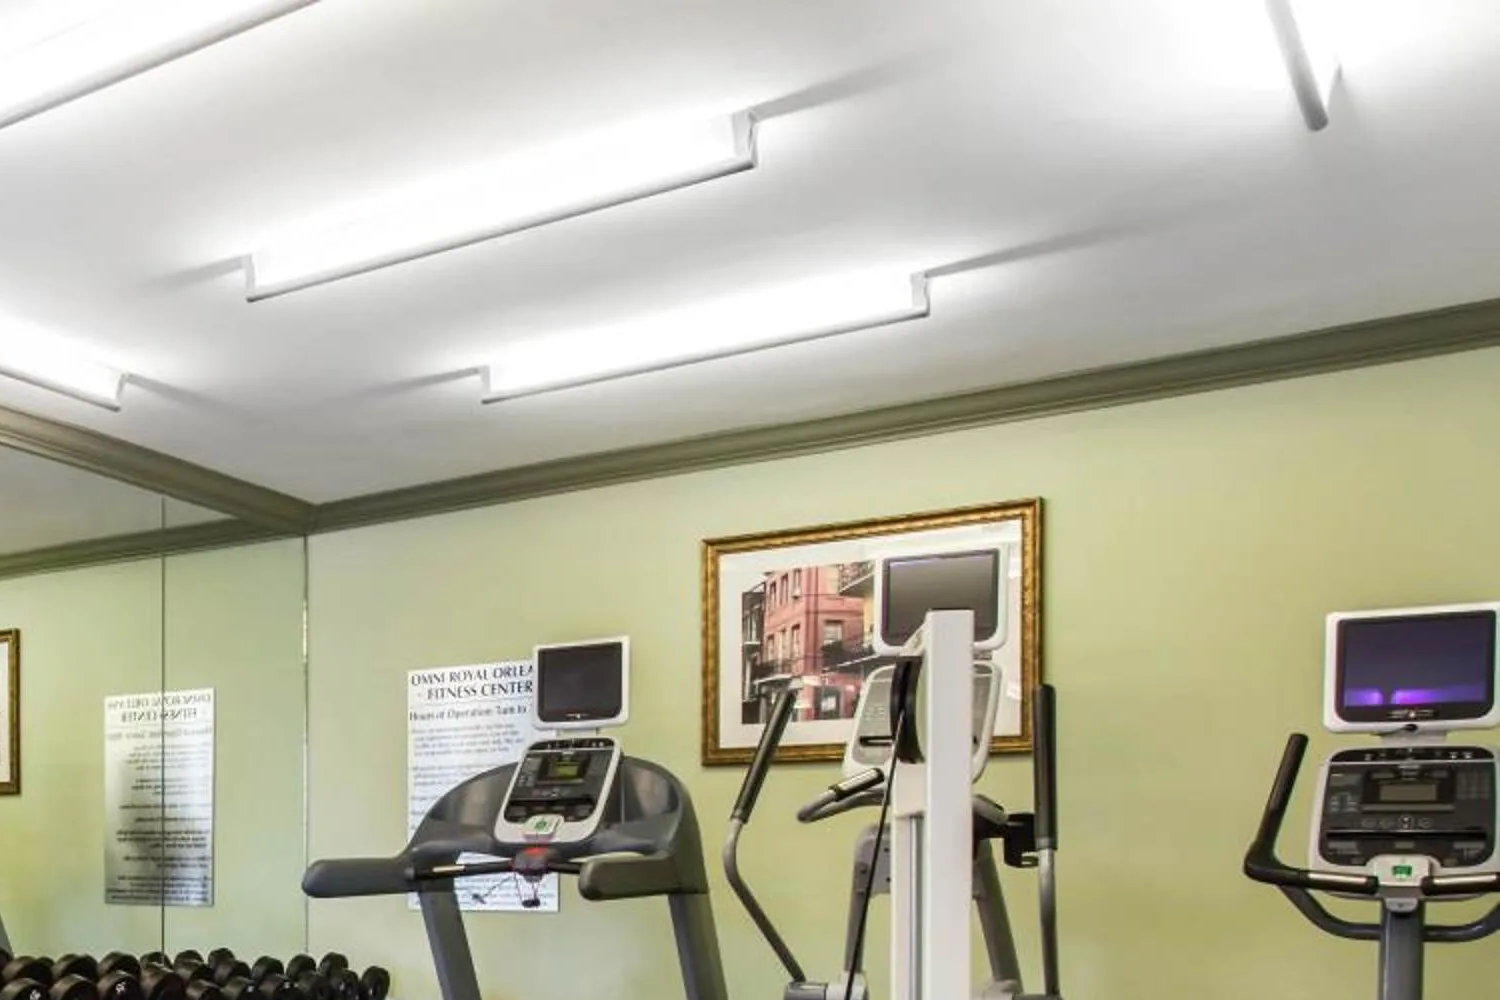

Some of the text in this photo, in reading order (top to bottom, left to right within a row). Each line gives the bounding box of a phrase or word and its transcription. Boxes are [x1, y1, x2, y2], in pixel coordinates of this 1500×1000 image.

[411, 671, 445, 686] OMNI
[449, 669, 489, 683] ROYAL
[427, 680, 533, 700] FITNESS CENTER
